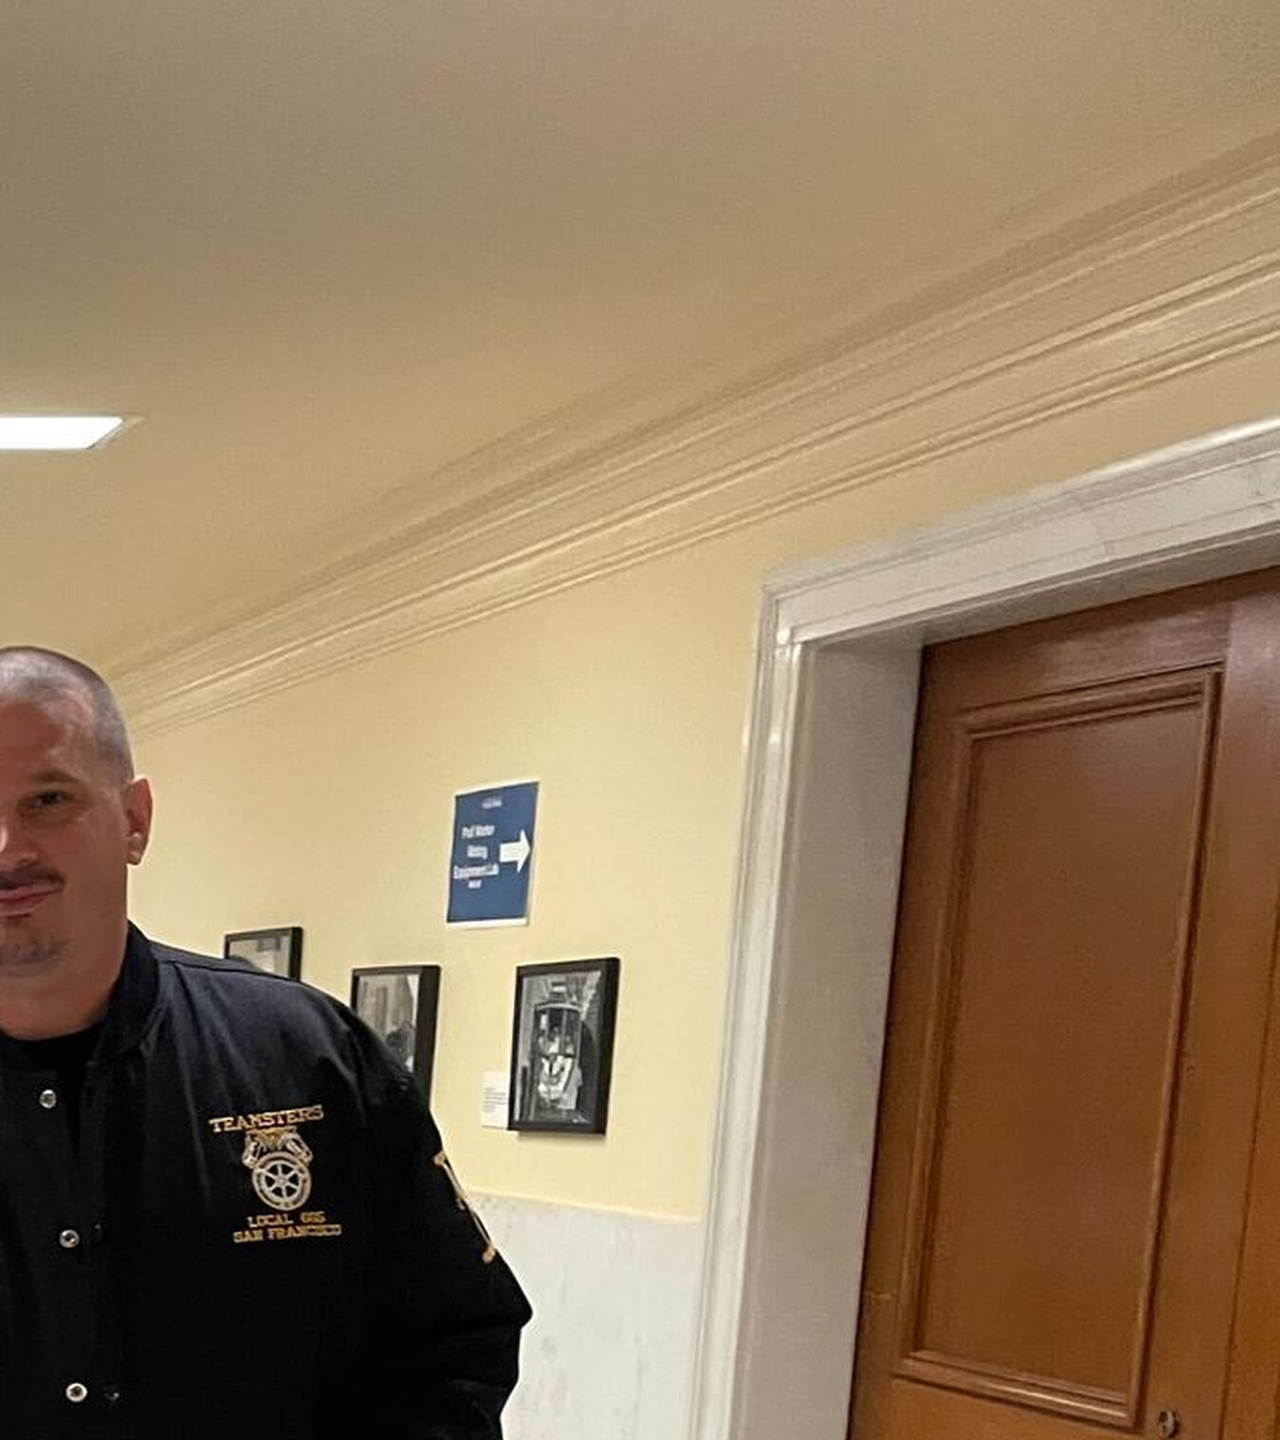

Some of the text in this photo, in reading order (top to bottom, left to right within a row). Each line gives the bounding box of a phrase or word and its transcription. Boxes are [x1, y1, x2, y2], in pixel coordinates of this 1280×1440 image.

[208, 1104, 324, 1133] TEAMSTERS
[246, 1213, 294, 1228] LOCAL
[232, 1223, 342, 1243] SAN FRANCISCO
